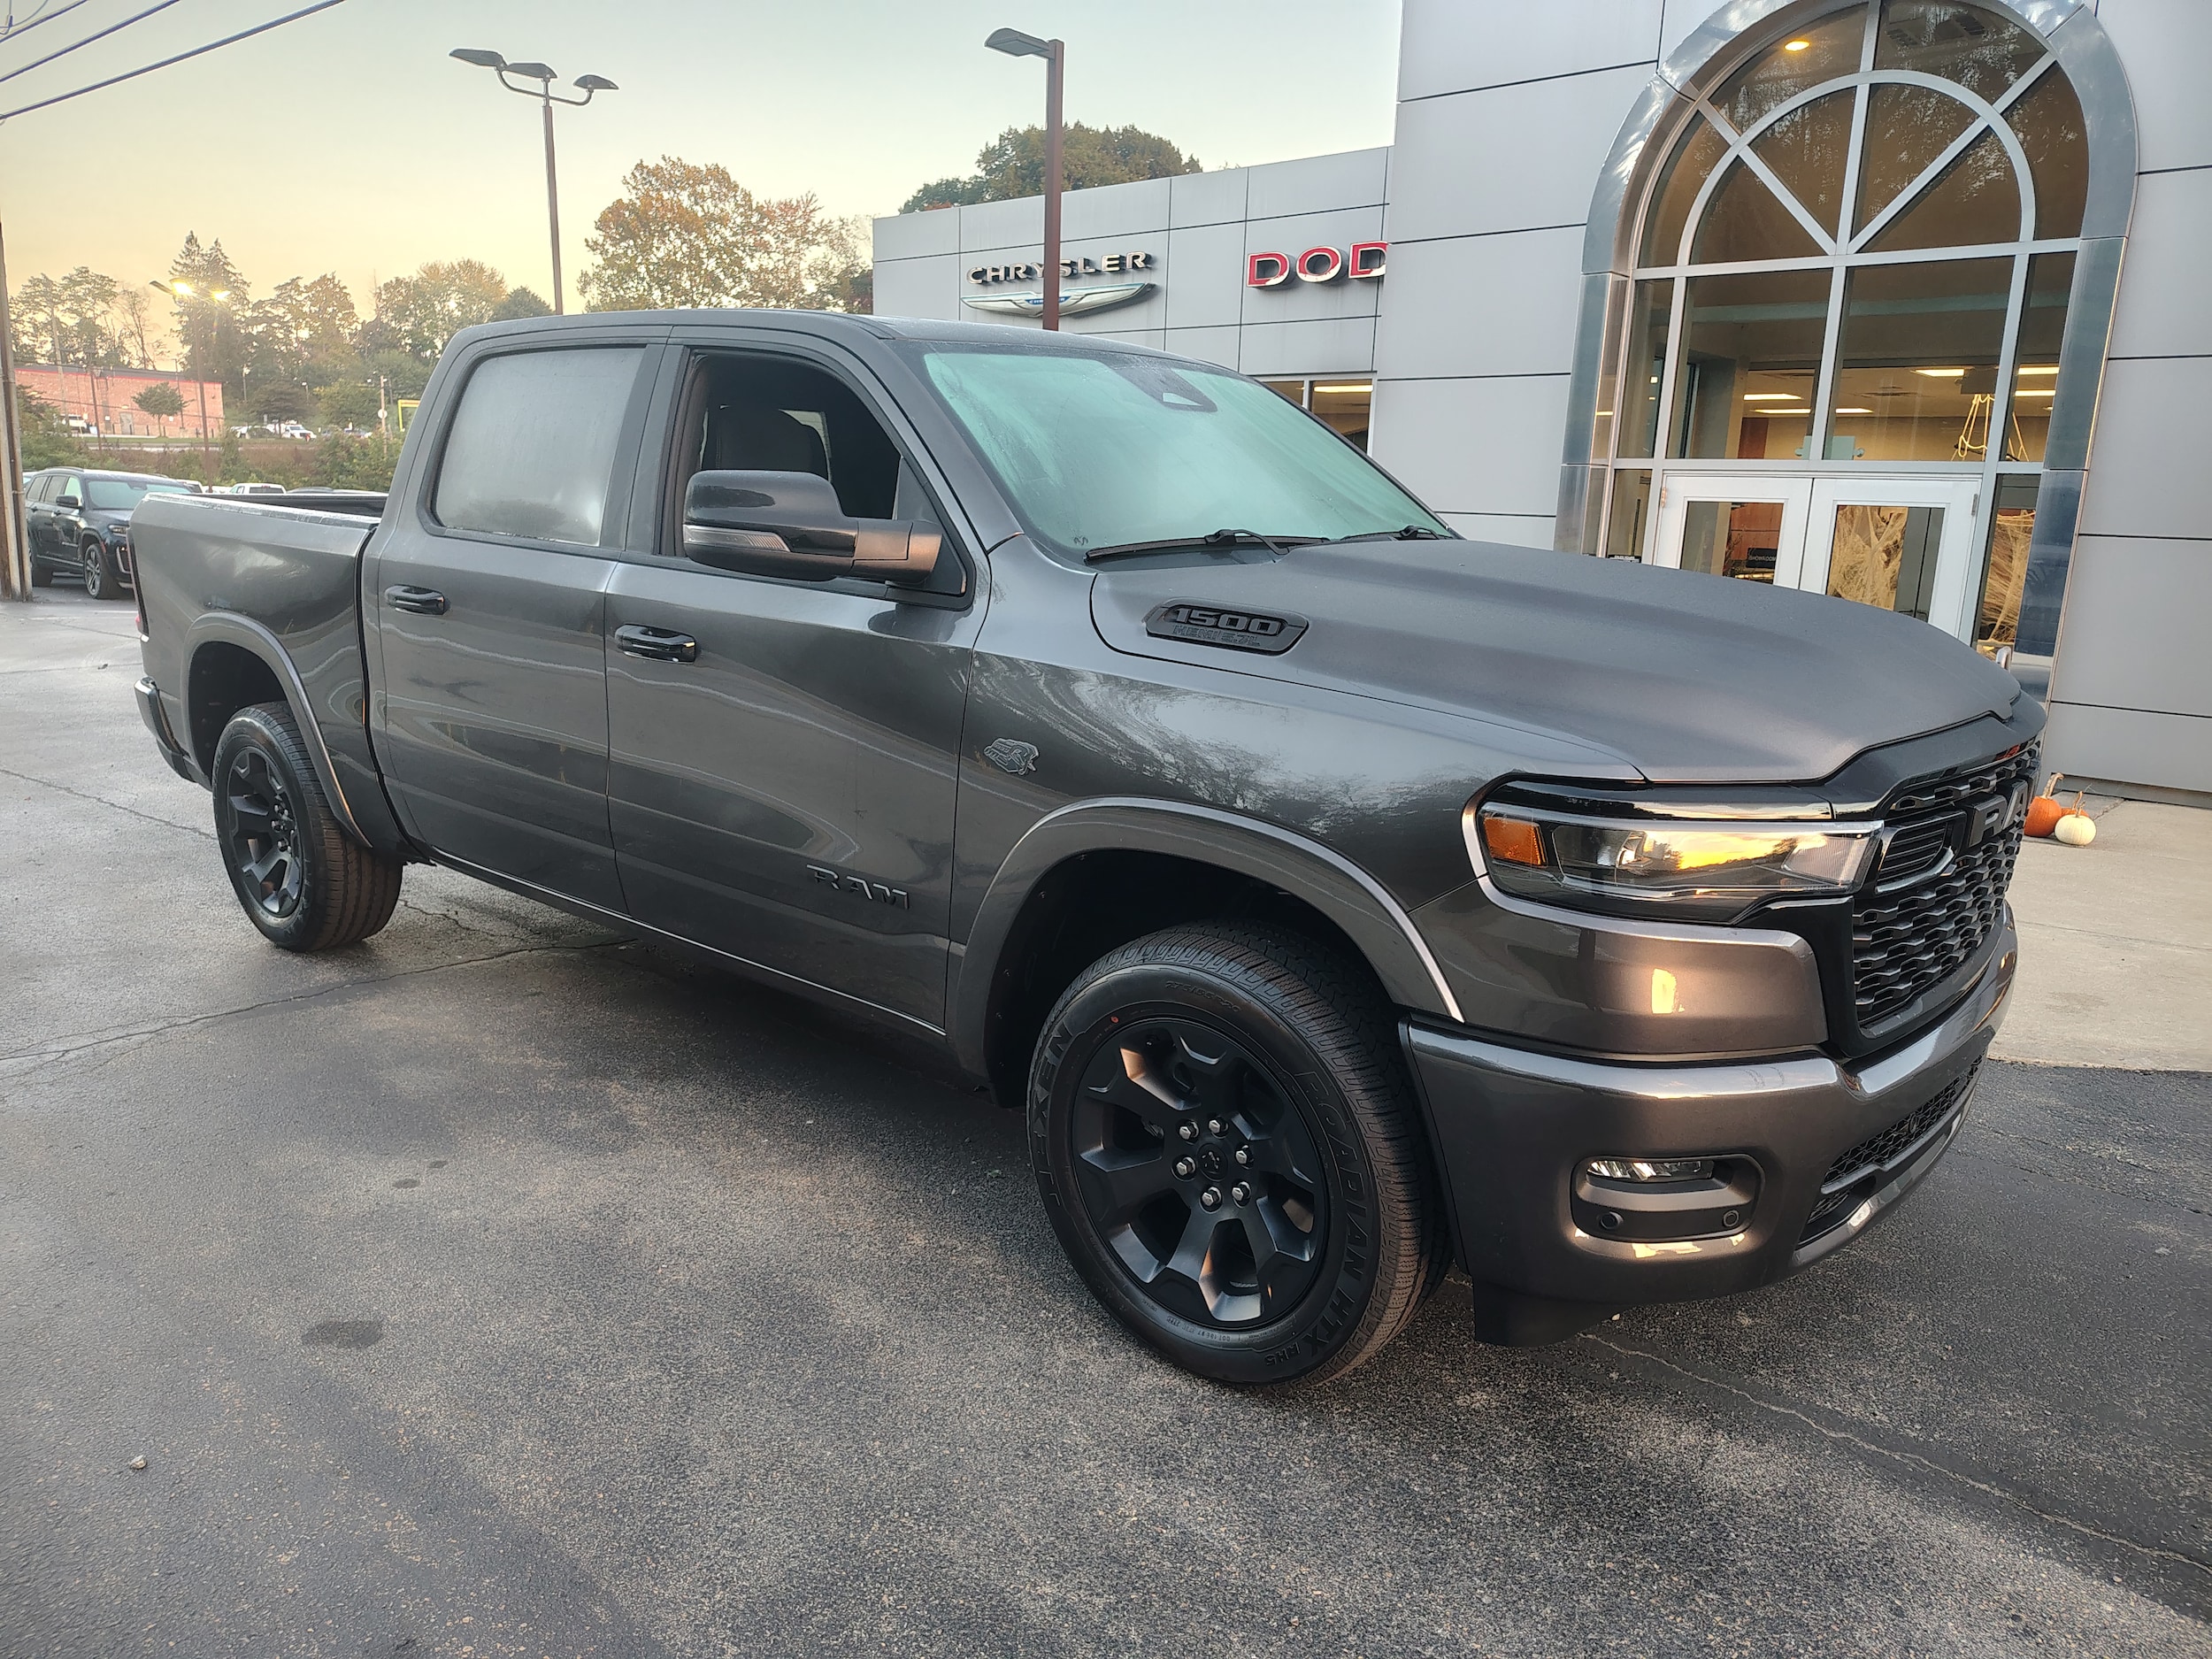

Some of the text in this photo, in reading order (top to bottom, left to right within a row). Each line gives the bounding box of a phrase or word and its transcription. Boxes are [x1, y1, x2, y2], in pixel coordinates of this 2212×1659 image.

[966, 251, 1148, 284] CHRYSLER
[1172, 624, 1217, 641] HEMI
[1175, 607, 1282, 635] 1500
[1967, 772, 2039, 848] RA
[803, 864, 910, 910] RAM
[1294, 1070, 1370, 1283] ROADIAN
